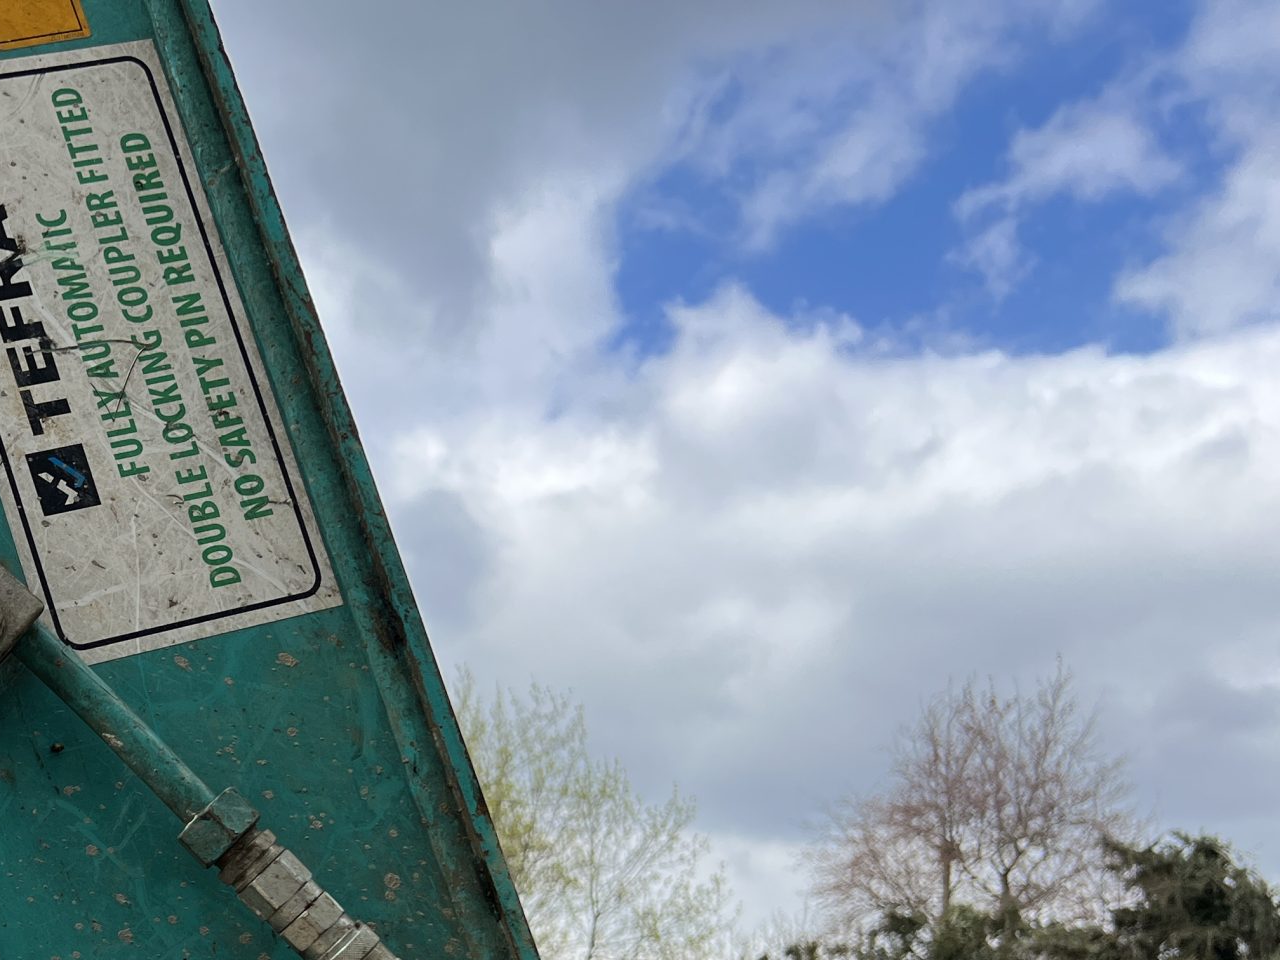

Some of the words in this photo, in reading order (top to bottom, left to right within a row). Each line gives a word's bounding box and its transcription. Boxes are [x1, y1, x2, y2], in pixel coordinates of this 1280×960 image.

[51, 88, 109, 185] FITTED
[85, 189, 154, 323] COUPLER
[120, 132, 196, 286] REQUIRED
[35, 209, 120, 378] AUTOMATIC
[172, 292, 217, 349] PIN
[92, 388, 151, 478] FULLY
[130, 329, 200, 460] LOCKING
[192, 356, 257, 468] SAFETY
[175, 464, 242, 588] DOUBLE
[234, 473, 274, 521] NO
